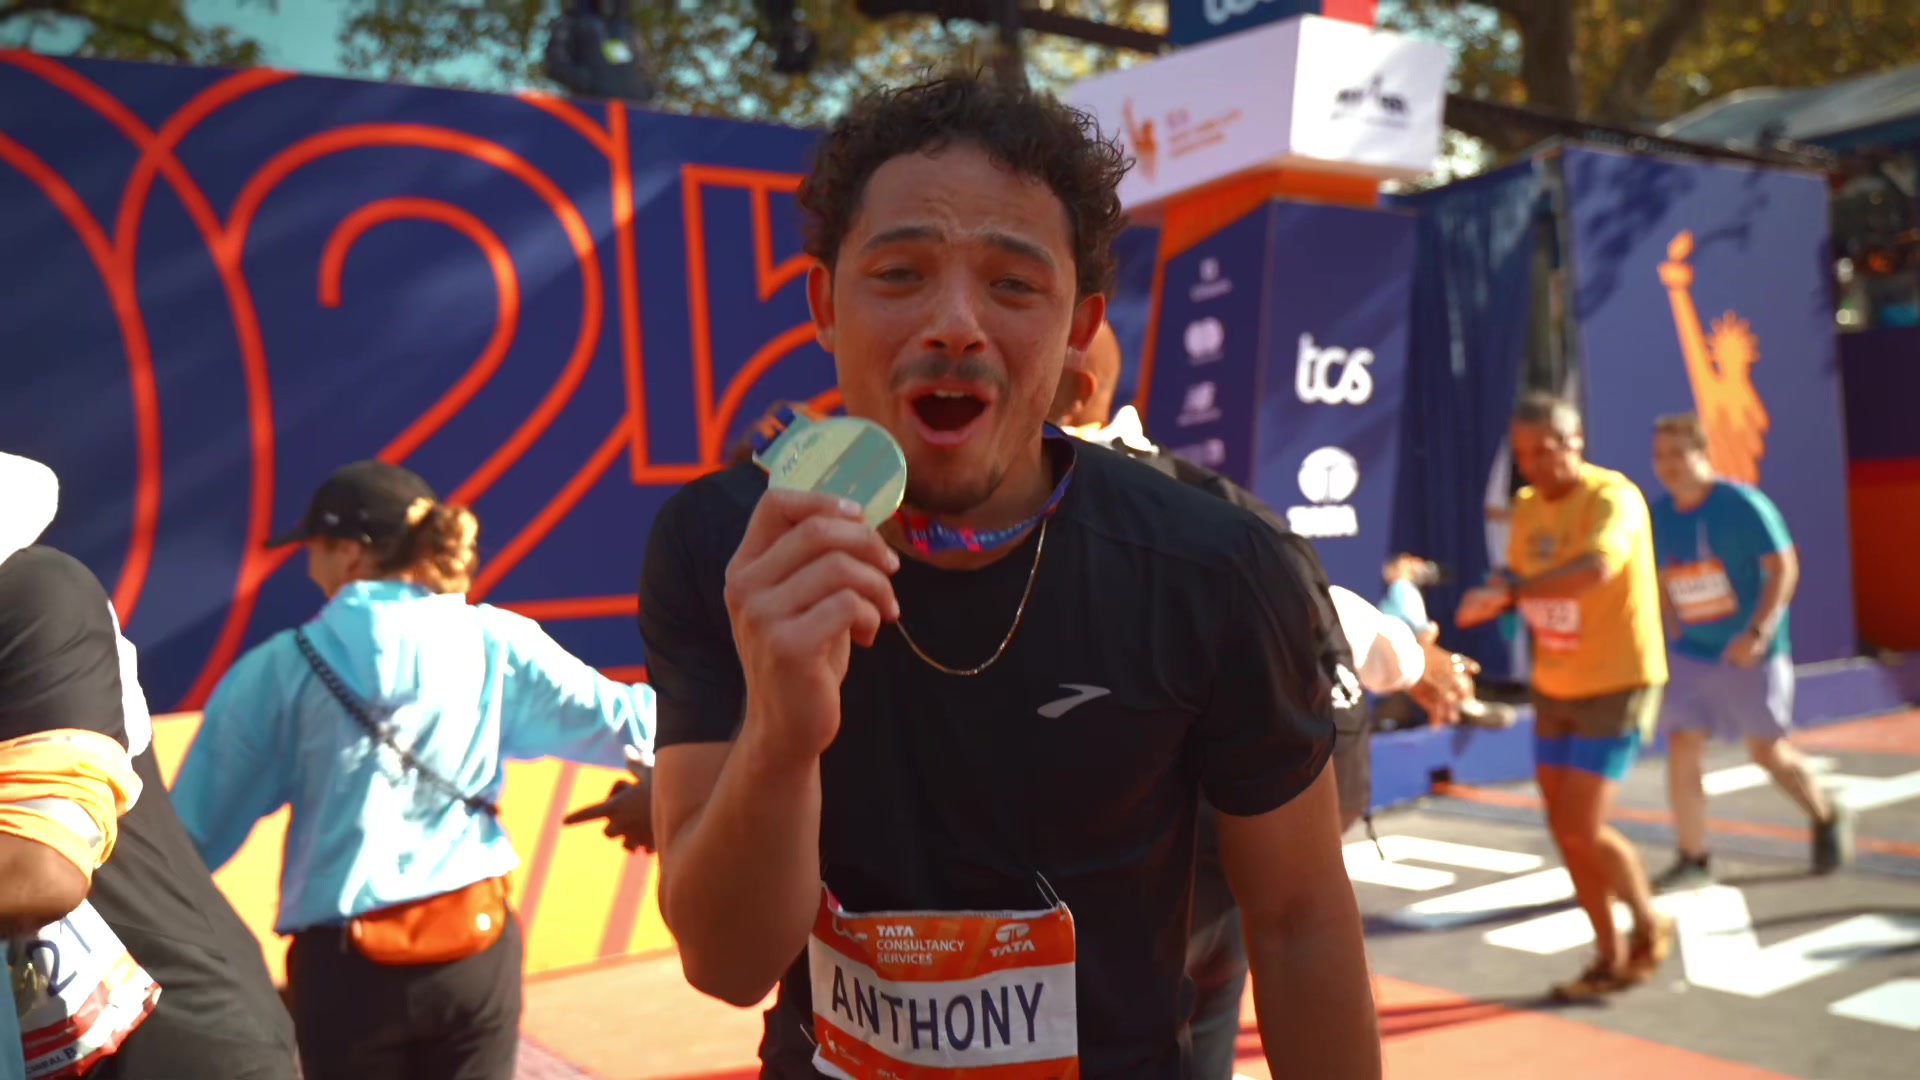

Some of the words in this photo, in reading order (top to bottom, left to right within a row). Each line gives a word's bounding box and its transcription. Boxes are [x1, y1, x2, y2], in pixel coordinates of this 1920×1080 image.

[1295, 332, 1375, 405] tcs
[876, 925, 914, 937] TATA
[876, 938, 965, 952] CONSULTANCY
[990, 940, 1036, 957] TATA
[876, 953, 933, 965] SERVICES
[831, 965, 1044, 1051] ANTHONY
